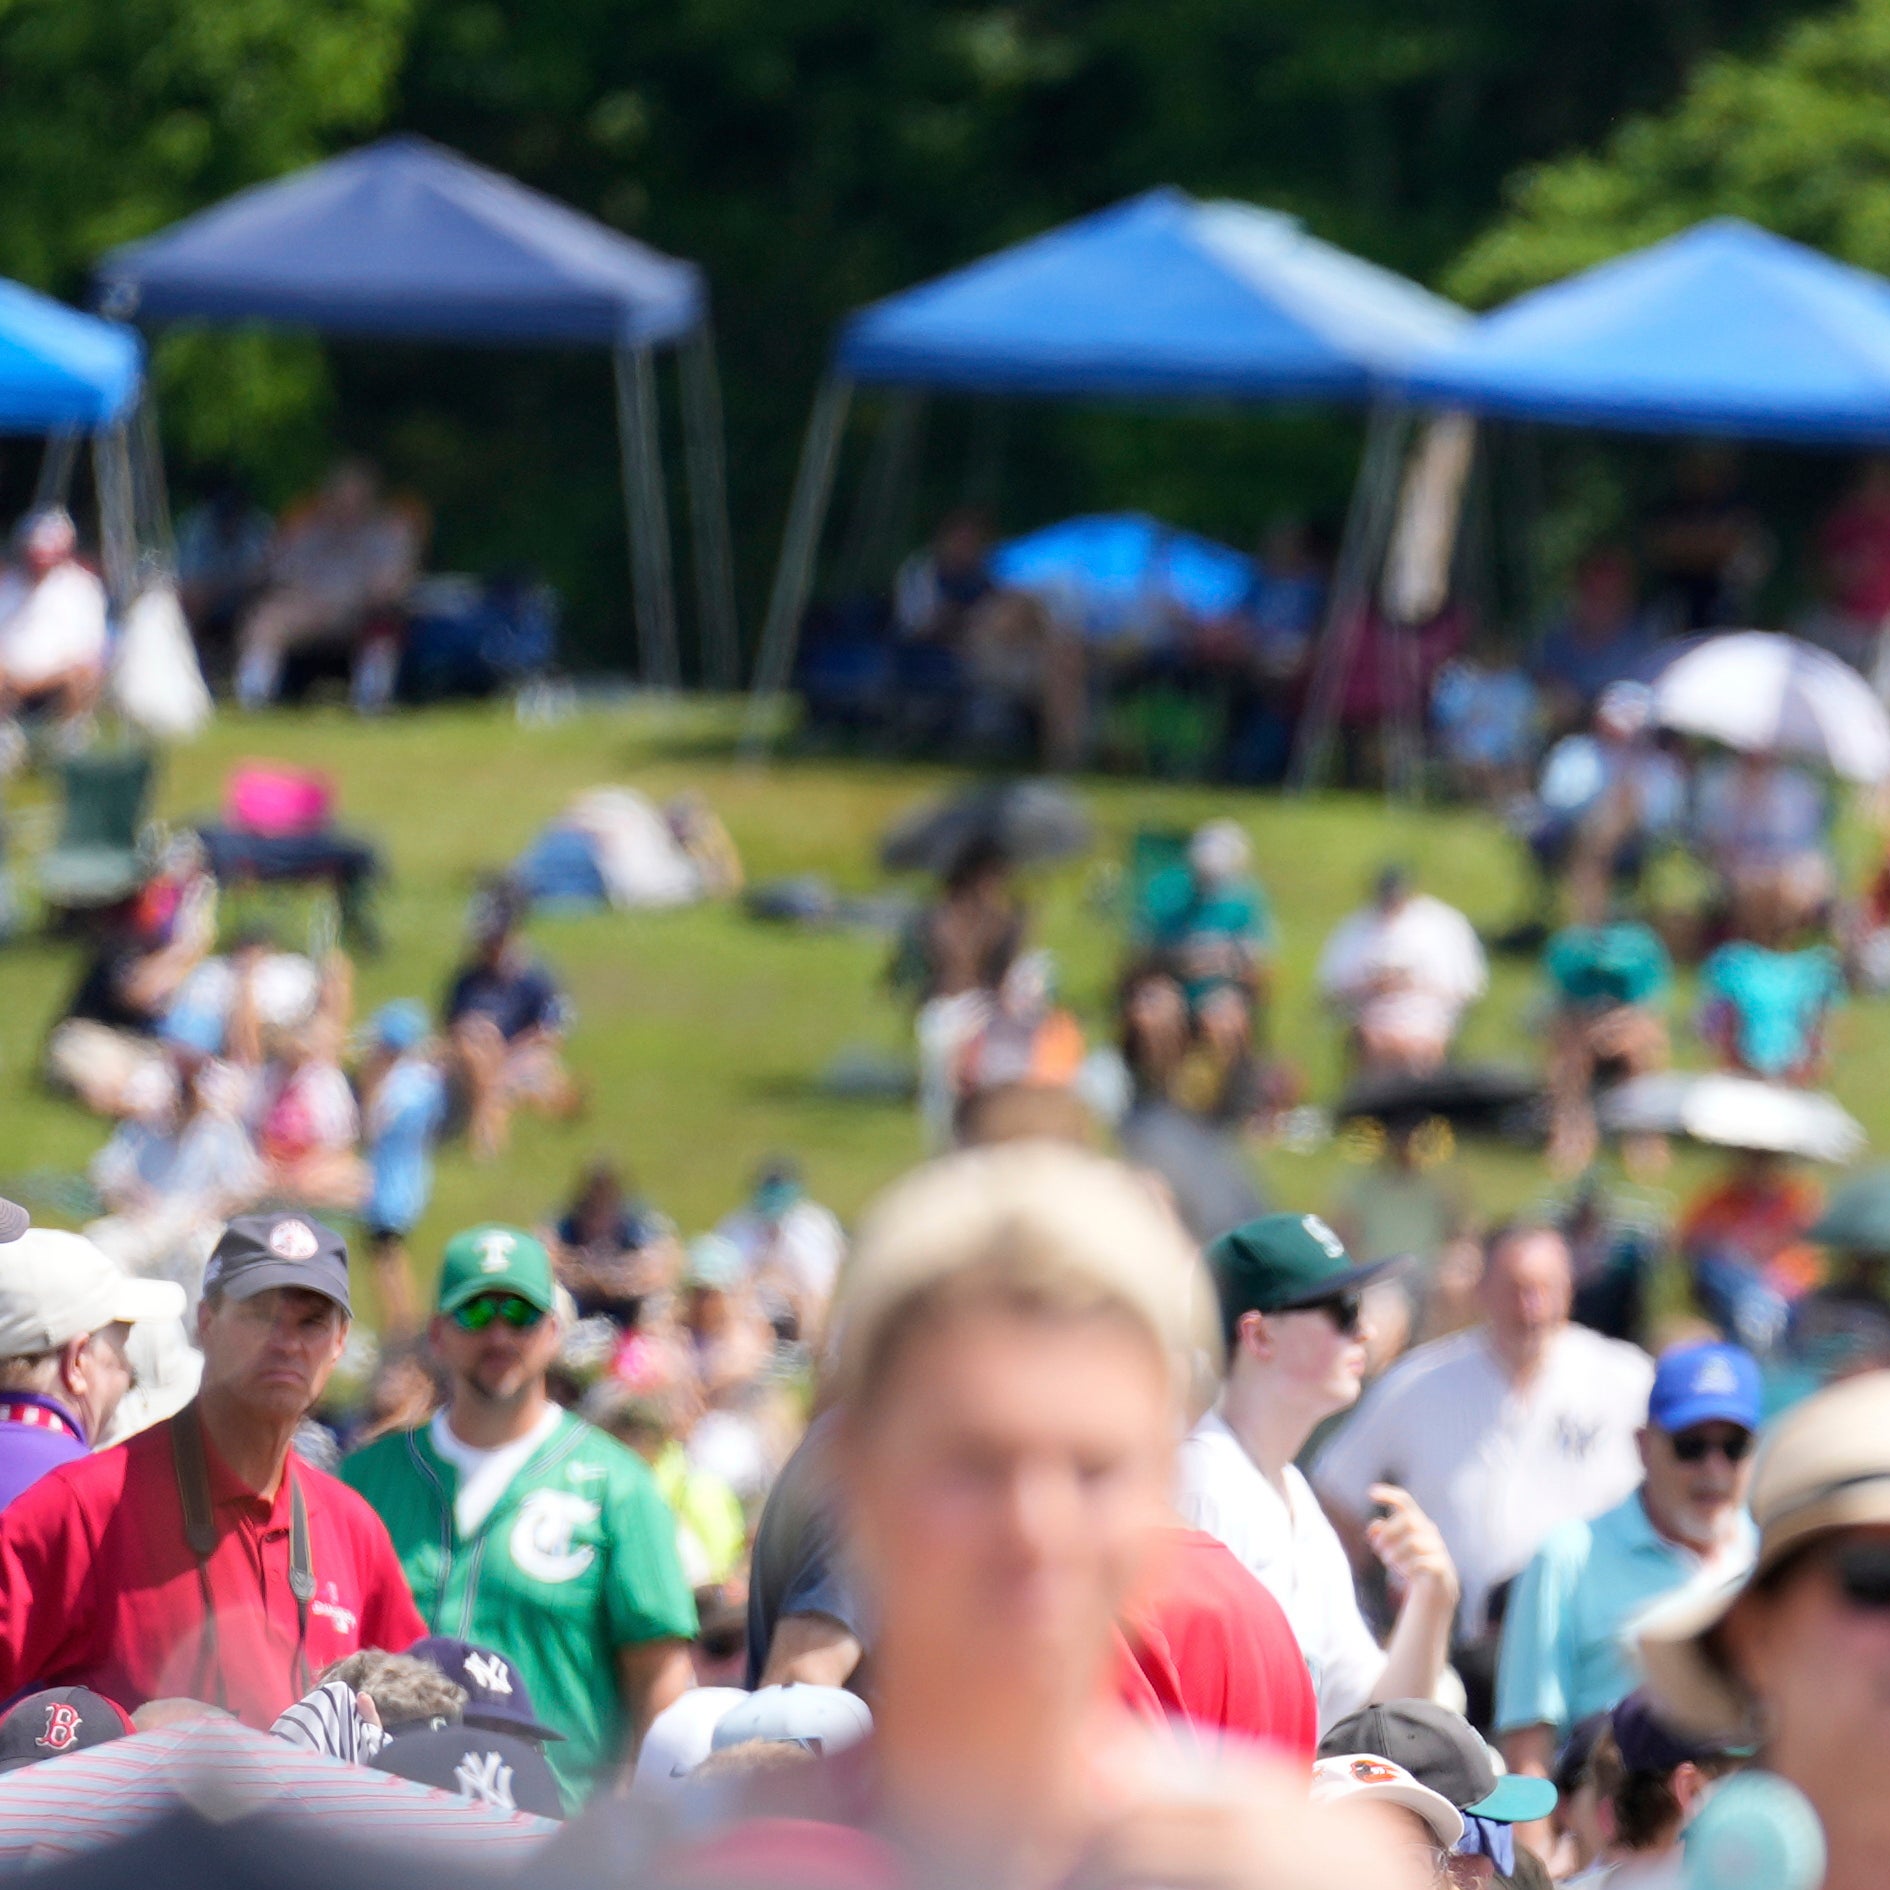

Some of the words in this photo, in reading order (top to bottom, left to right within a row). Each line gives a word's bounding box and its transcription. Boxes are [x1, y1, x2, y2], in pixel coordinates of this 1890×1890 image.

[463, 1651, 513, 1695] NY
[35, 1702, 84, 1749] B
[454, 1751, 517, 1810] NY
